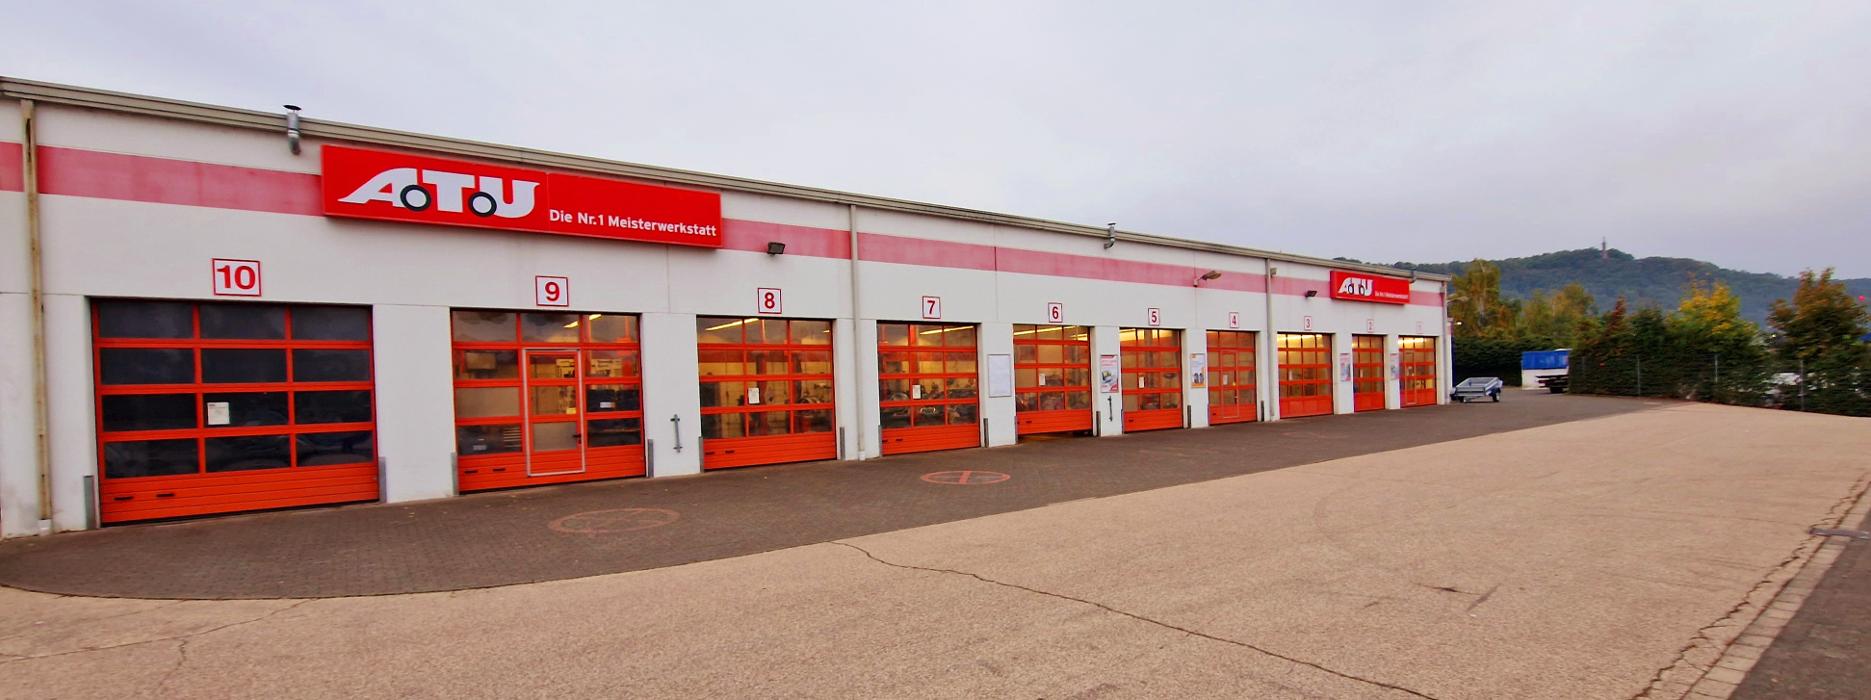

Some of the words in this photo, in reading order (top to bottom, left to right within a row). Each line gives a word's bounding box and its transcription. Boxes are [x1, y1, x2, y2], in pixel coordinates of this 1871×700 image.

[549, 209, 573, 223] Die
[577, 212, 604, 226] Nr.1
[608, 215, 717, 237] Meisterwerkstatt
[216, 265, 257, 290] 10
[544, 281, 560, 302] 9
[1338, 277, 1373, 297] ATU
[764, 292, 776, 309] 8
[927, 300, 936, 316] 7
[1051, 306, 1060, 320] 6
[1151, 311, 1158, 323] 5
[1231, 315, 1237, 325] 4
[1306, 318, 1311, 328] 3
